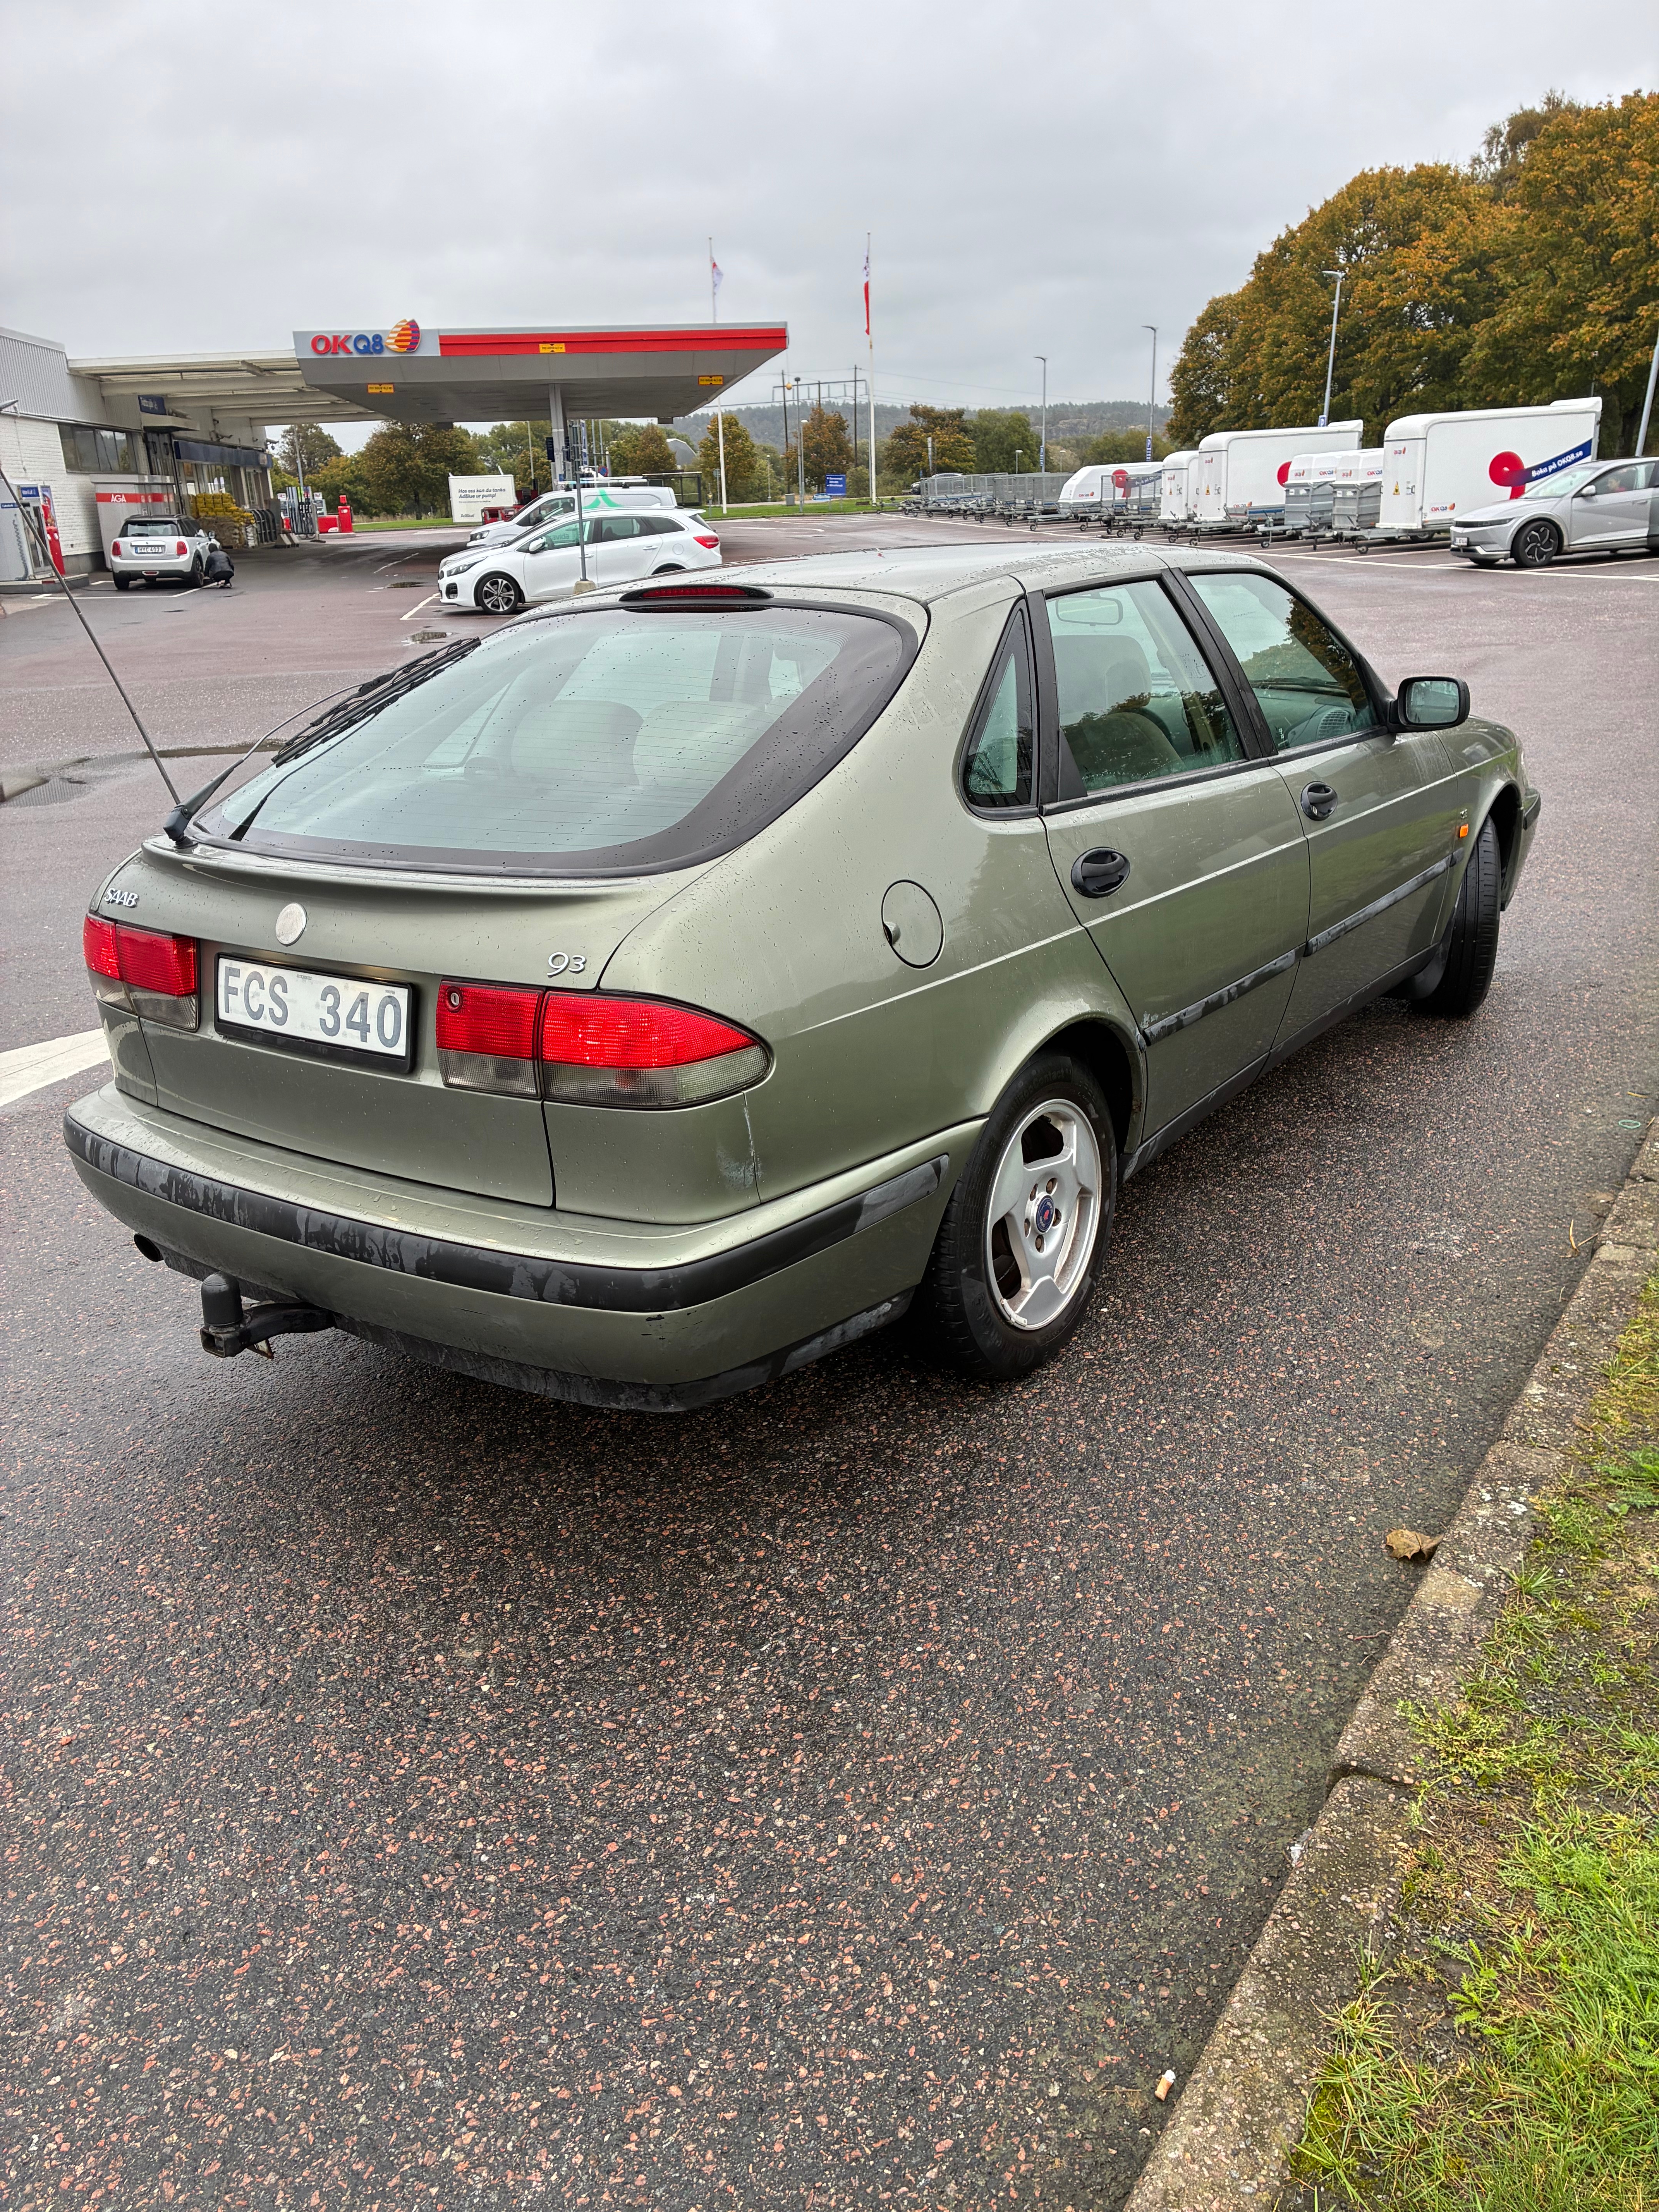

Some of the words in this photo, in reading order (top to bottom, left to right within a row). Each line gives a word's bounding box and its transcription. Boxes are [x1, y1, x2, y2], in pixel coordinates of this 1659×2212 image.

[311, 334, 384, 354] OKQ8
[1532, 467, 1548, 477] Boka
[1548, 462, 1557, 473] på
[1557, 450, 1583, 467] OKQ8.se
[111, 494, 126, 502] AGA
[104, 888, 138, 907] SAAB
[547, 952, 586, 976] 93
[224, 966, 288, 1026] FCS
[319, 985, 402, 1048] 340
